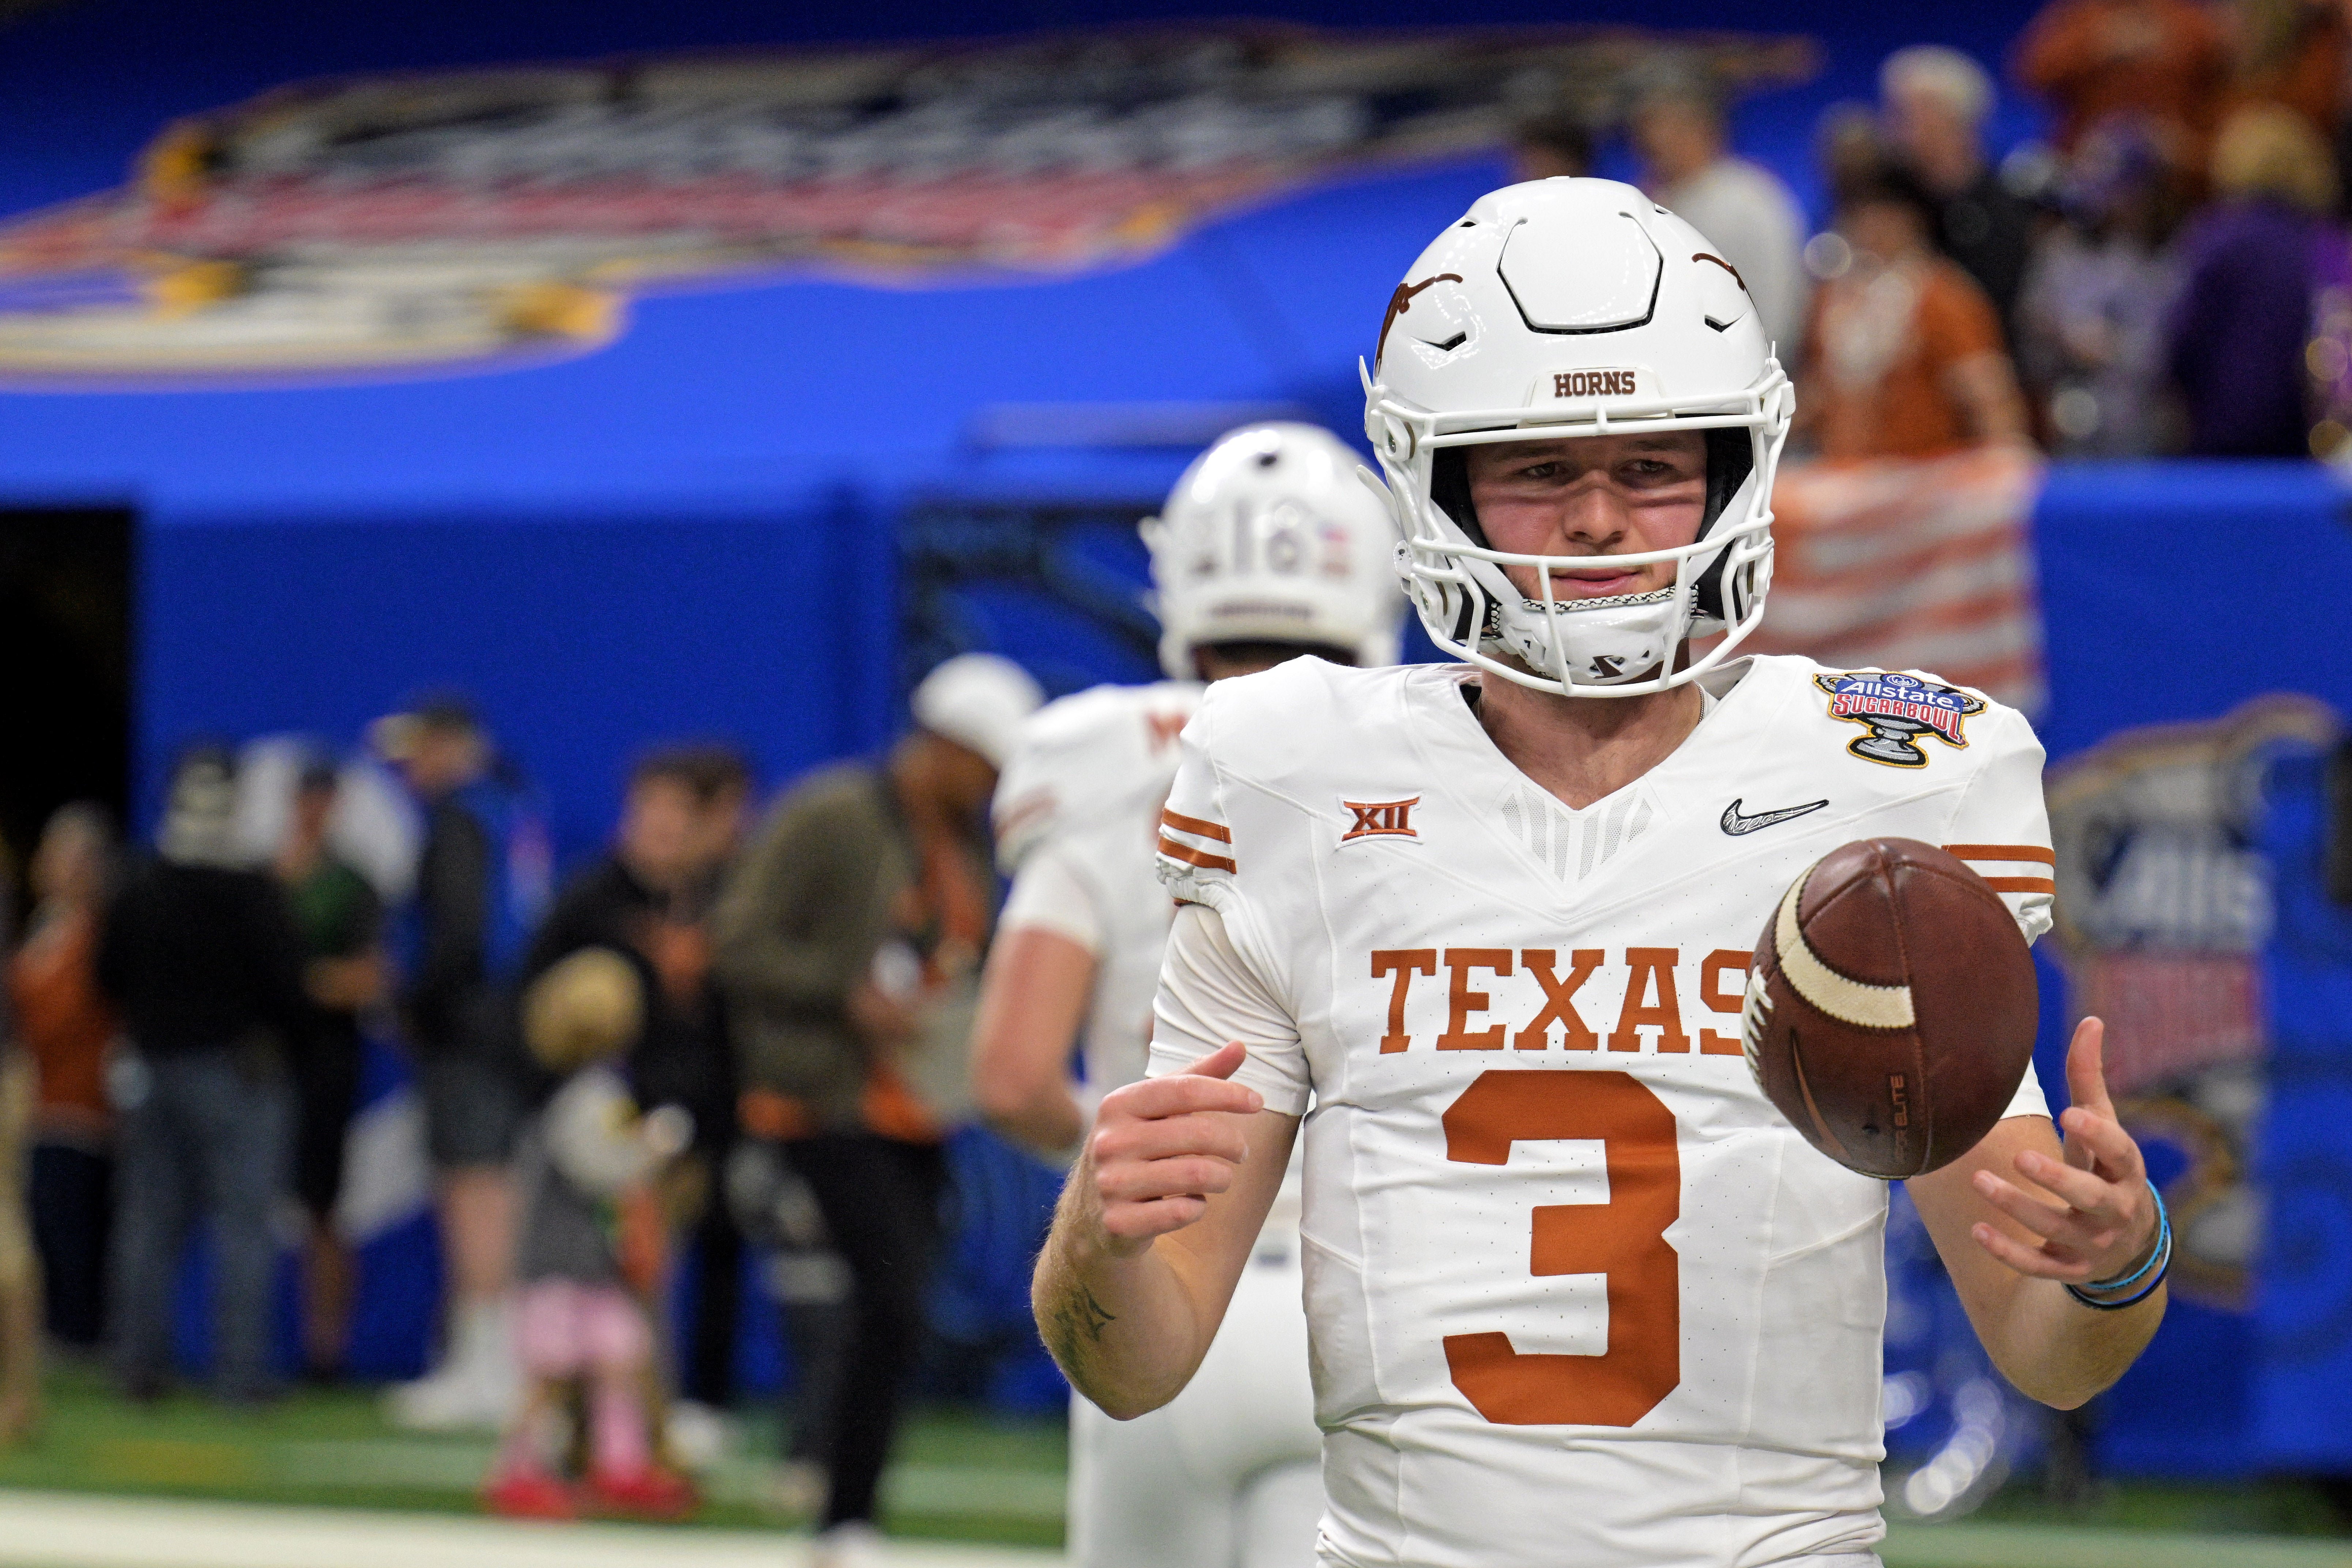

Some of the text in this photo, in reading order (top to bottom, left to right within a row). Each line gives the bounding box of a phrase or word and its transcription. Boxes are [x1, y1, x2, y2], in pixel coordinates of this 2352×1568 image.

[1554, 371, 1635, 397] HORNS
[1841, 682, 1954, 708] Allstate
[1341, 796, 1420, 842] XII
[1371, 948, 1754, 1056] TEXAS
[1442, 1069, 1681, 1428] 3
